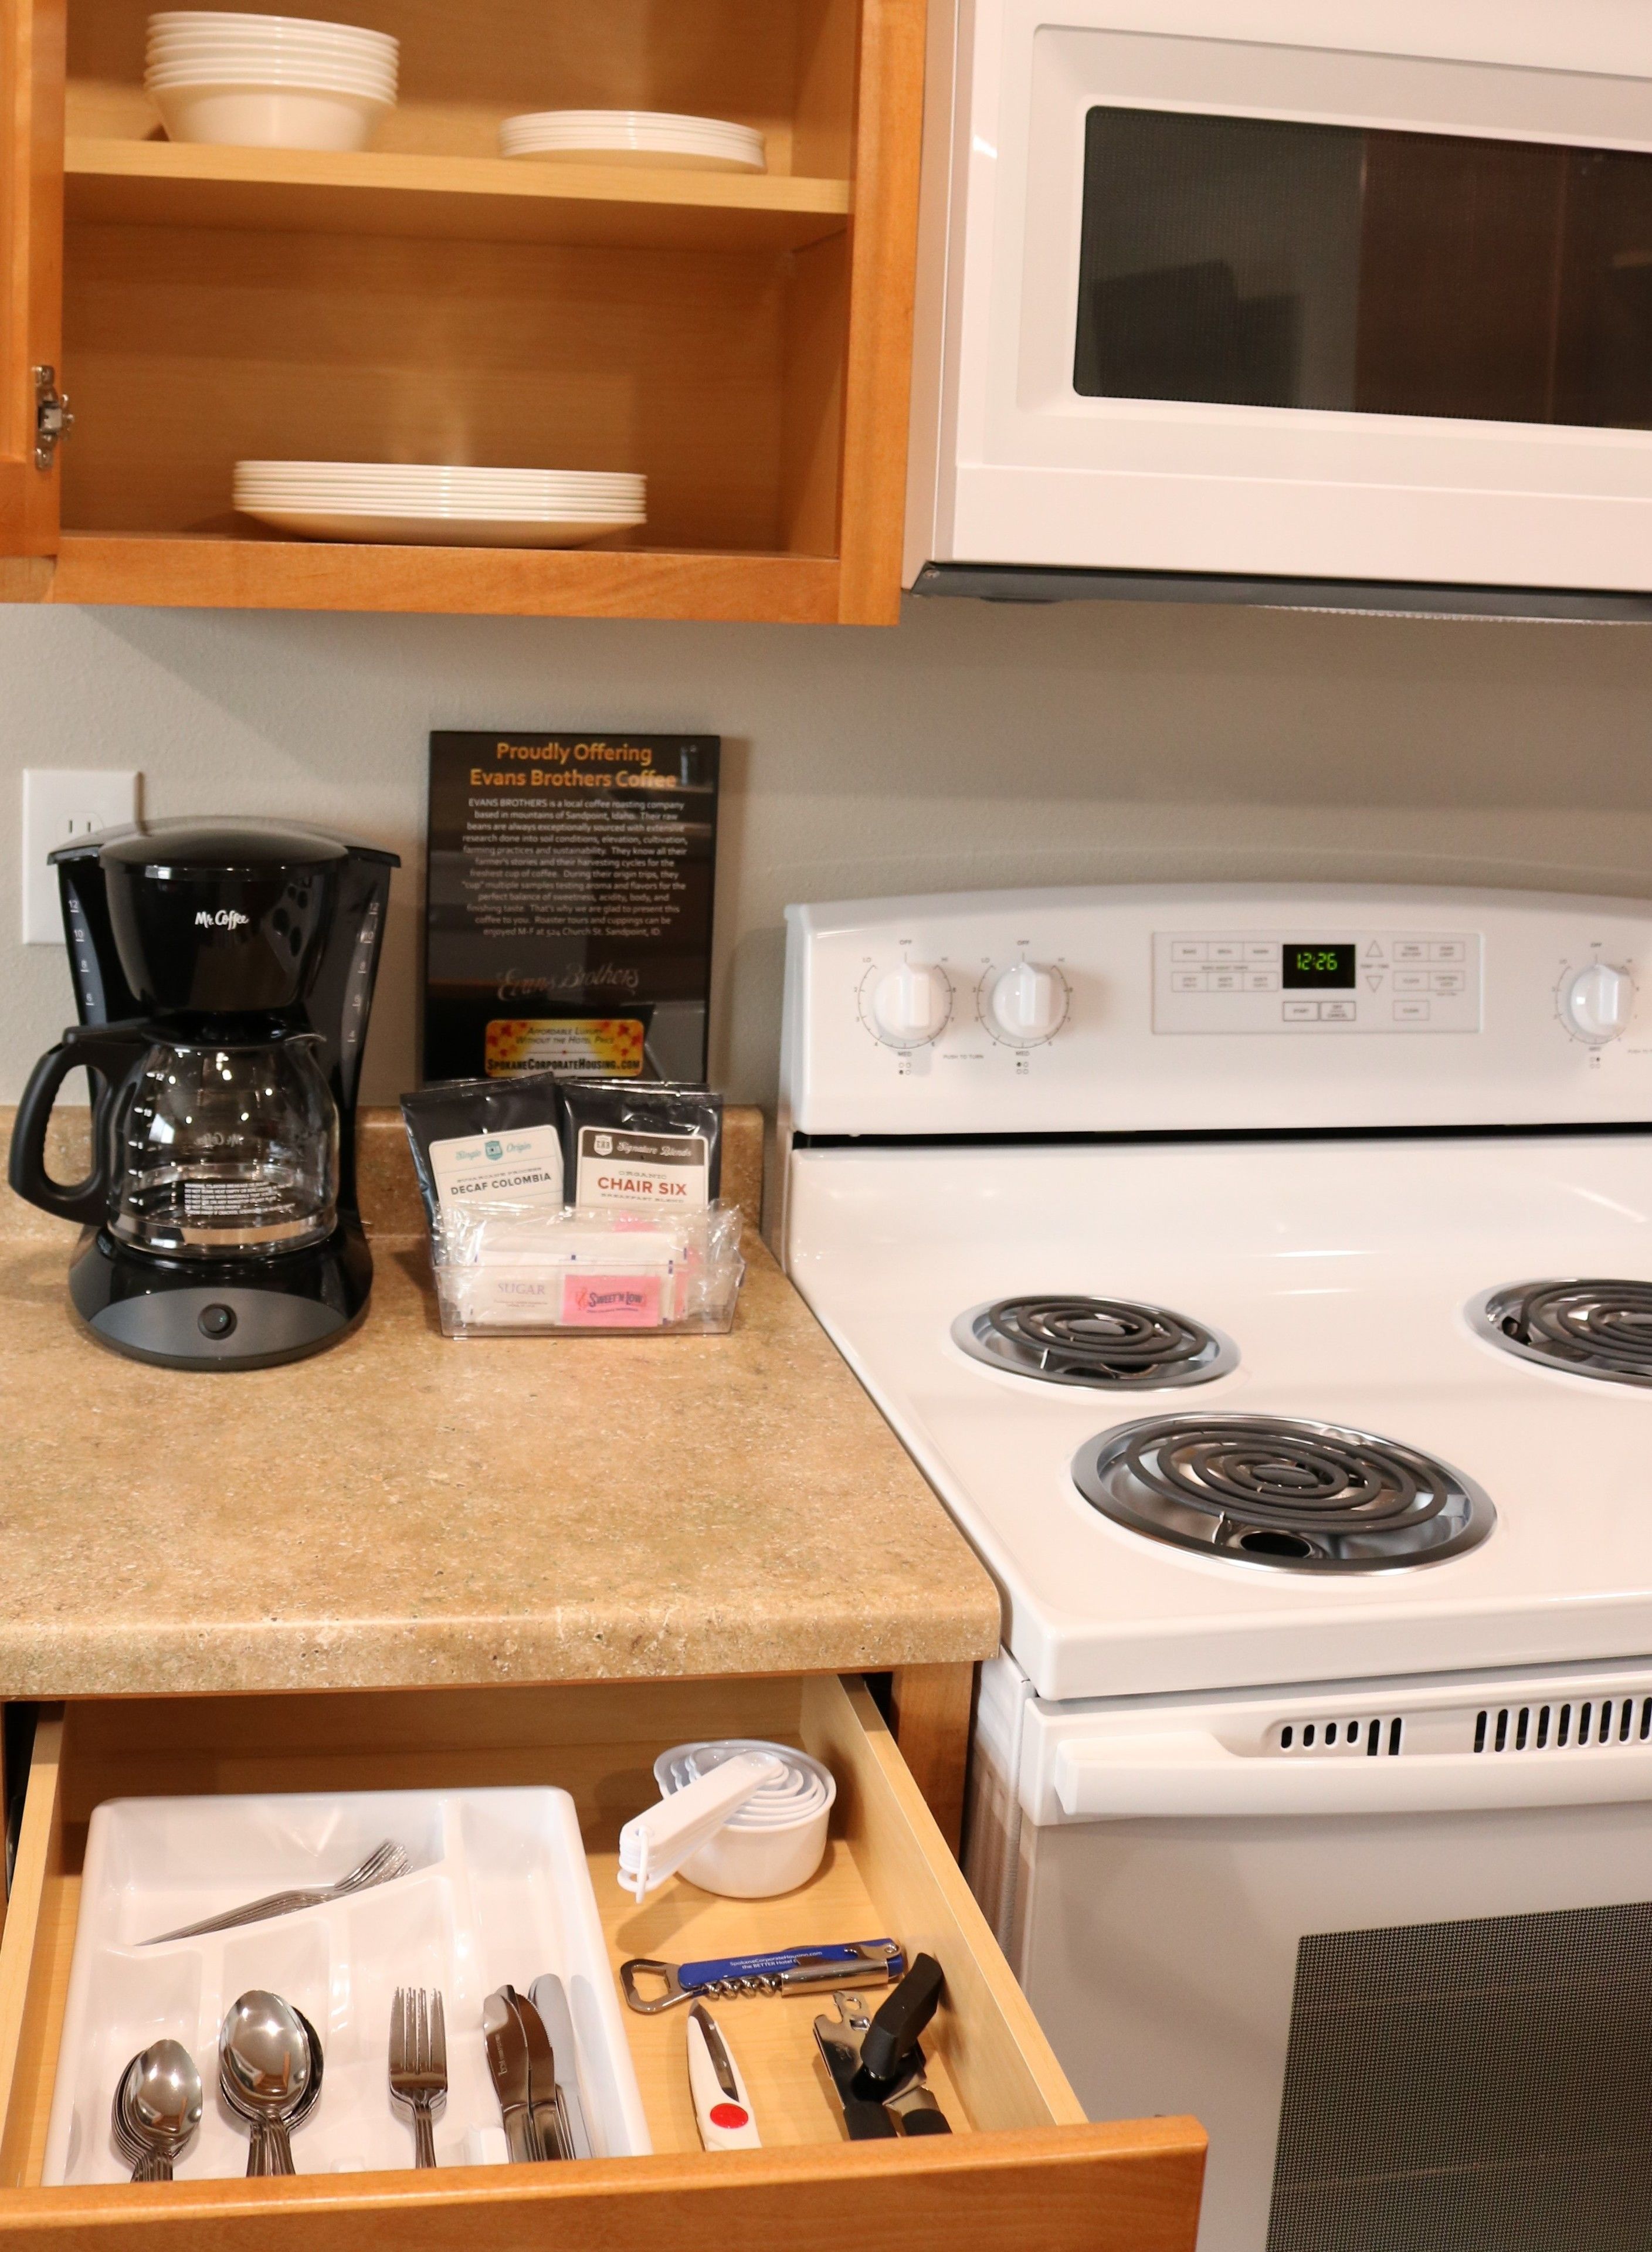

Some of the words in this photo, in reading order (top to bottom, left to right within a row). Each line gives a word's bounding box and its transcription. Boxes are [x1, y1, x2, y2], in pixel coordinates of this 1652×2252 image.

[497, 742, 570, 765] Proudly
[574, 742, 652, 766] Offering
[470, 768, 526, 786] Evans
[531, 769, 611, 786] Brothers
[616, 769, 676, 788] Coffee
[469, 798, 497, 807] EVANS
[500, 798, 547, 807] BROTHERS
[564, 799, 584, 808] local
[584, 800, 610, 808] coffee
[612, 801, 645, 810] roasting
[647, 802, 684, 810] company
[475, 810, 498, 819] based
[565, 811, 609, 820] Sandpoint,
[640, 812, 661, 820] Their
[467, 822, 491, 830] beans
[508, 823, 536, 832] always
[538, 823, 591, 833] exceptionally
[555, 835, 600, 844] conditions,
[602, 836, 641, 844] elevation,
[643, 836, 688, 844] cultivation,
[463, 846, 495, 855] farming
[497, 847, 534, 855] practices
[612, 847, 630, 856] They
[475, 857, 509, 866] farmer's
[577, 859, 620, 868] harvesting
[622, 859, 646, 868] cycles
[647, 859, 659, 867] for
[470, 869, 503, 877] freshest
[521, 869, 530, 877] of
[564, 870, 591, 880] During
[613, 871, 637, 880] origin
[660, 871, 679, 880] they
[630, 881, 657, 890] flavors
[659, 881, 671, 890] for
[479, 893, 508, 901] perfect
[542, 892, 551, 900] of
[552, 894, 597, 903] sweetness,
[69, 900, 79, 908] 12
[370, 903, 380, 911] 12
[467, 904, 501, 914] finishing
[557, 905, 574, 914] why
[603, 905, 621, 914] glad
[633, 906, 663, 914] present
[195, 911, 214, 928] Mr.
[215, 909, 249, 930] Coffee
[607, 918, 643, 926] cuppings
[661, 916, 671, 924] be
[74, 929, 83, 938] 10
[483, 928, 516, 937] enjoyed
[562, 928, 590, 936] Church
[605, 928, 649, 937] Sandpoint,
[1297, 952, 1338, 970] 12:26
[558, 963, 639, 990] Brothers
[456, 1151, 482, 1160] Single
[507, 1142, 532, 1153] Origin
[617, 1141, 657, 1154] Signature
[660, 1146, 691, 1156] Blends
[451, 1182, 488, 1195] DECAF
[491, 1173, 551, 1189] COLOMBIA
[598, 1177, 652, 1193] CHAIR
[659, 1182, 687, 1195] SIX
[498, 1283, 544, 1295] SUGAR
